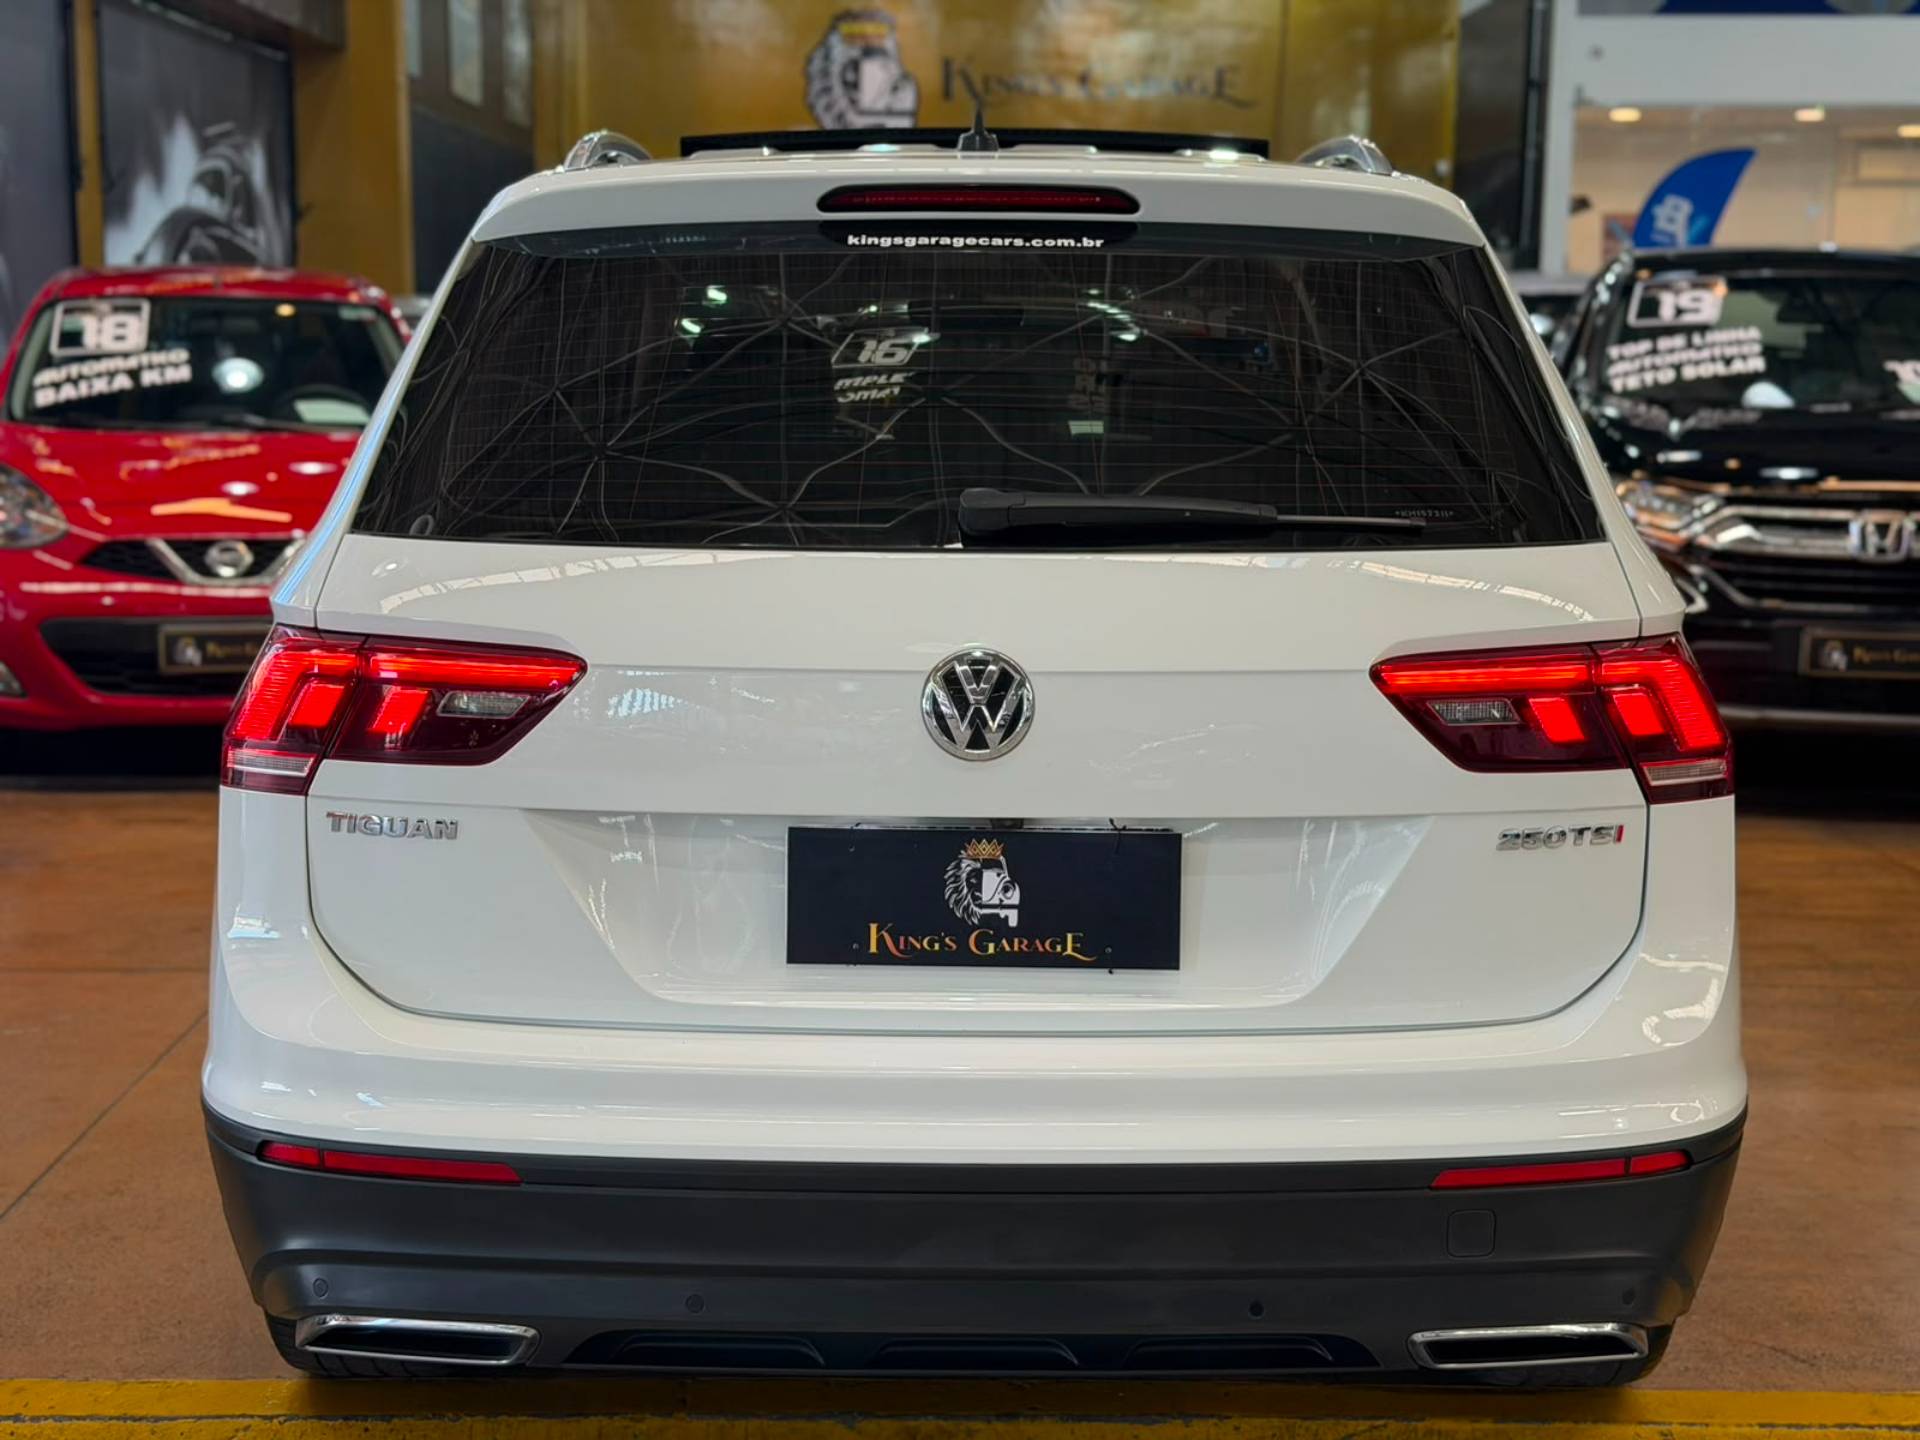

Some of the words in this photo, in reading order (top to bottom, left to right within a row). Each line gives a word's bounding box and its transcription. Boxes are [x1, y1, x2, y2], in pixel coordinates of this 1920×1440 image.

[848, 234, 1104, 248] kingsgaragecars.com.br
[82, 311, 142, 352] 18
[858, 339, 911, 365] 16
[33, 372, 135, 409] BAIXA
[139, 364, 193, 388] KM
[326, 811, 459, 841] TIGUAN
[1496, 824, 1625, 851] 250TSI
[869, 922, 957, 958] KING'S
[968, 928, 1097, 962] GARAGE
